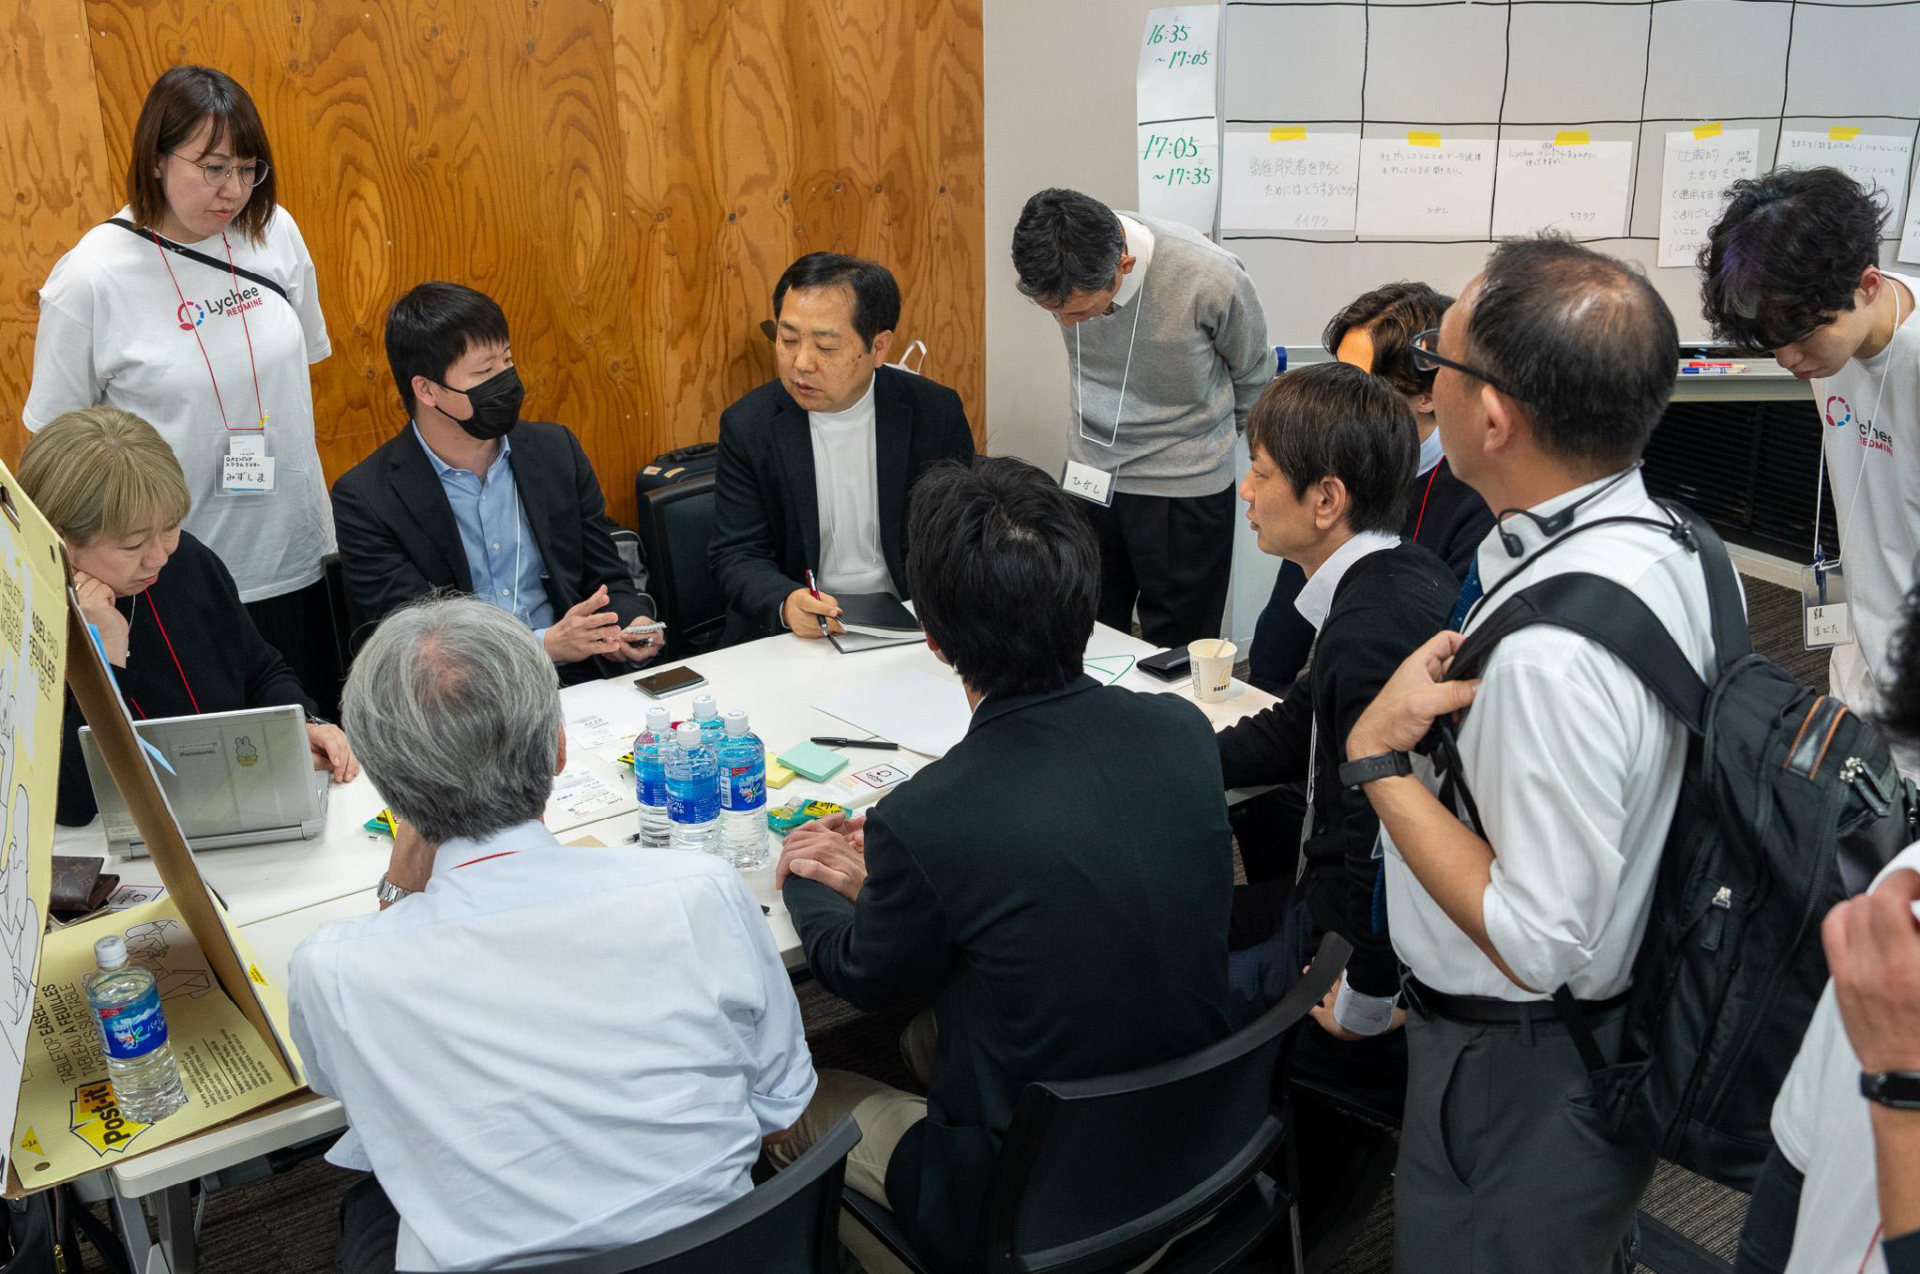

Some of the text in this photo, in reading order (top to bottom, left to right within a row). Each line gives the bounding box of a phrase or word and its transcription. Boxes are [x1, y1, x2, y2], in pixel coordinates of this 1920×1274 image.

[1147, 24, 1191, 45] 16:35
[1143, 134, 1199, 160] 17:05
[205, 286, 259, 315] Lychee
[226, 297, 263, 317] REDMINE
[226, 471, 266, 483] みずしま
[42, 983, 73, 1027] FEUILLES
[59, 982, 83, 1010] TABLE
[73, 1008, 94, 1030] SUR
[33, 1005, 77, 1084] TABLETOP EASEL
[67, 1034, 97, 1077] TABLEAU
[83, 1086, 131, 1145] Post-it
